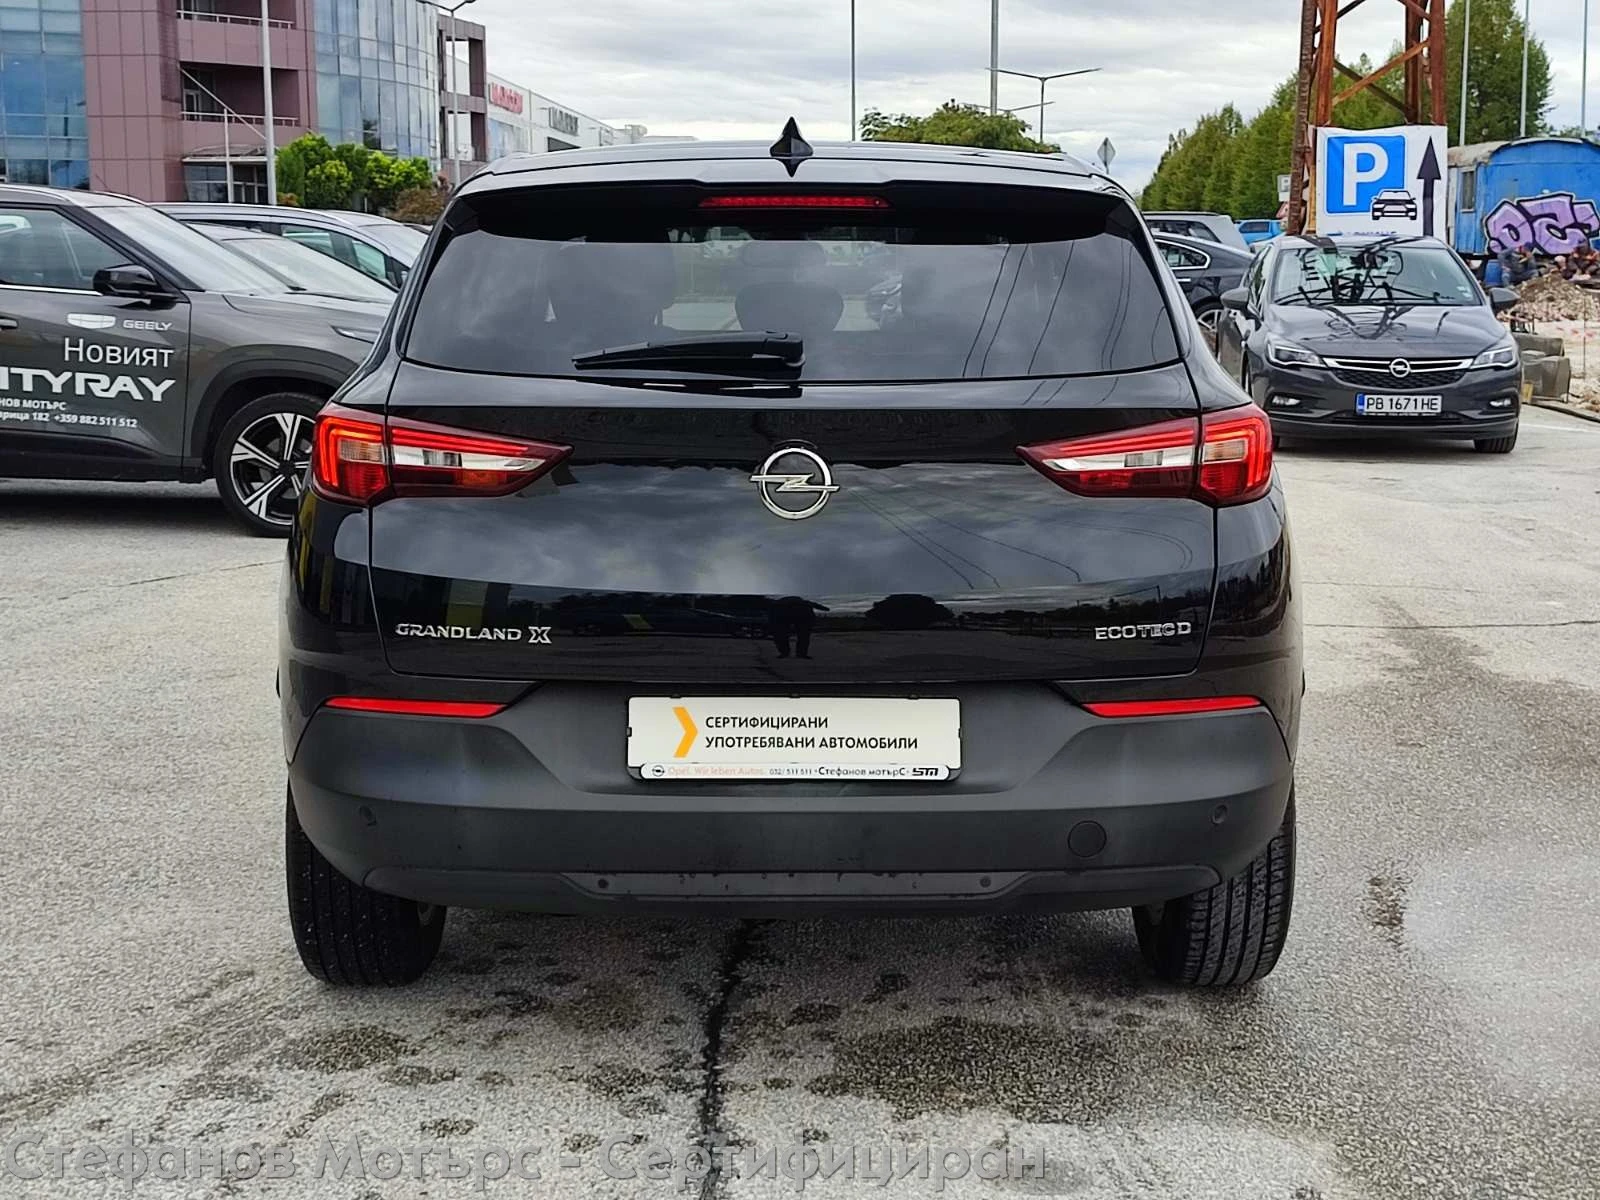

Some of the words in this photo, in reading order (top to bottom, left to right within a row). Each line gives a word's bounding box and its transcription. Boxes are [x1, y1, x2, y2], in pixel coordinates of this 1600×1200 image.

[1343, 143, 1389, 206] P
[122, 320, 172, 331] GEELY
[0, 366, 176, 402] ITYRAY
[22, 399, 67, 411] МОТЪРС
[1366, 397, 1384, 410] PB
[1388, 397, 1418, 410] 1671
[1421, 397, 1439, 411] HE
[32, 412, 50, 422] 182
[54, 414, 78, 425] +359
[79, 415, 98, 426] 882
[99, 417, 117, 427] 511
[119, 418, 138, 429] 512
[395, 623, 522, 641] GRANDLAND
[527, 626, 552, 643] X
[705, 716, 829, 732] СЕРТИФИЦИРАНИ
[705, 736, 815, 750] УПОТРЕБЯВАНИ
[818, 737, 919, 751] АВТОМОБИЛИ
